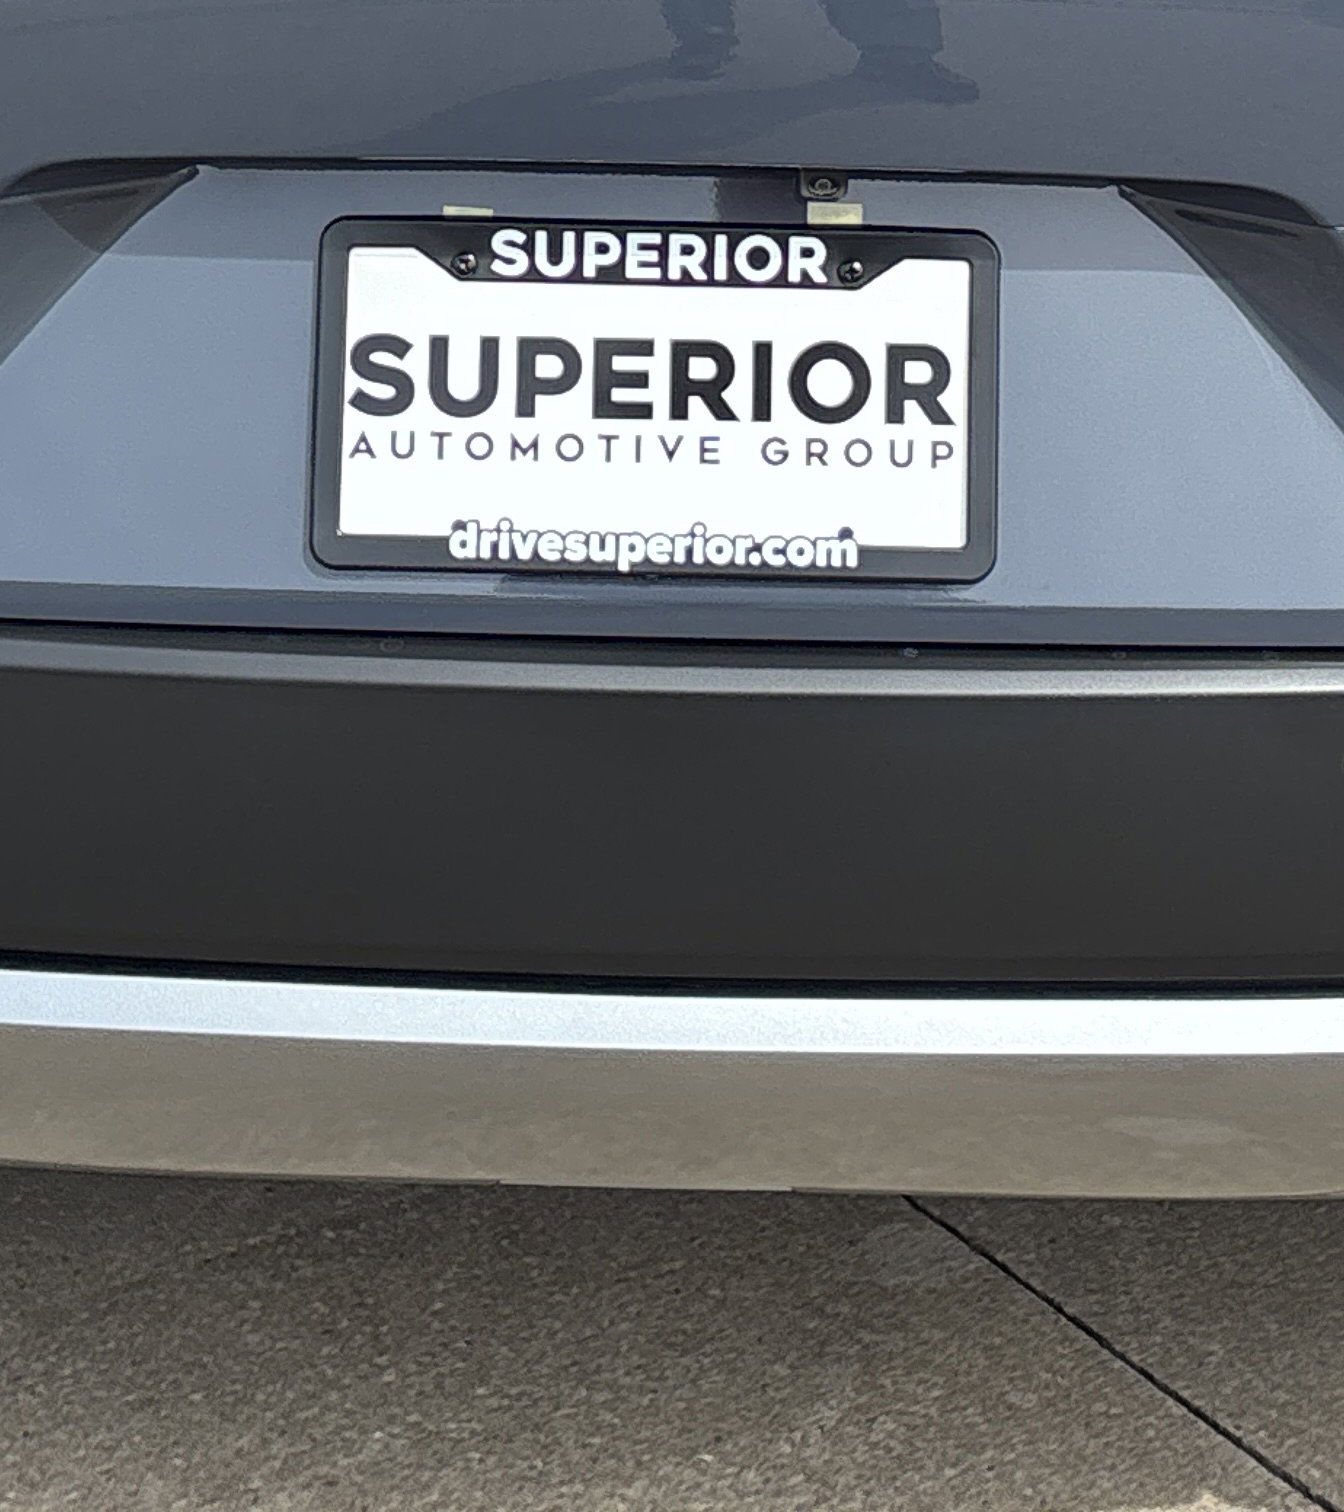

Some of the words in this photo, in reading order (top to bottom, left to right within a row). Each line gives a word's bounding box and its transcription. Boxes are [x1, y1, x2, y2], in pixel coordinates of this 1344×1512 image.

[489, 227, 829, 285] SUPERIOR
[347, 332, 956, 427] SUPERIOR
[347, 430, 722, 466] AUTOMOTIVE
[760, 435, 955, 469] GROUP
[448, 516, 860, 571] drivesuperior.com
